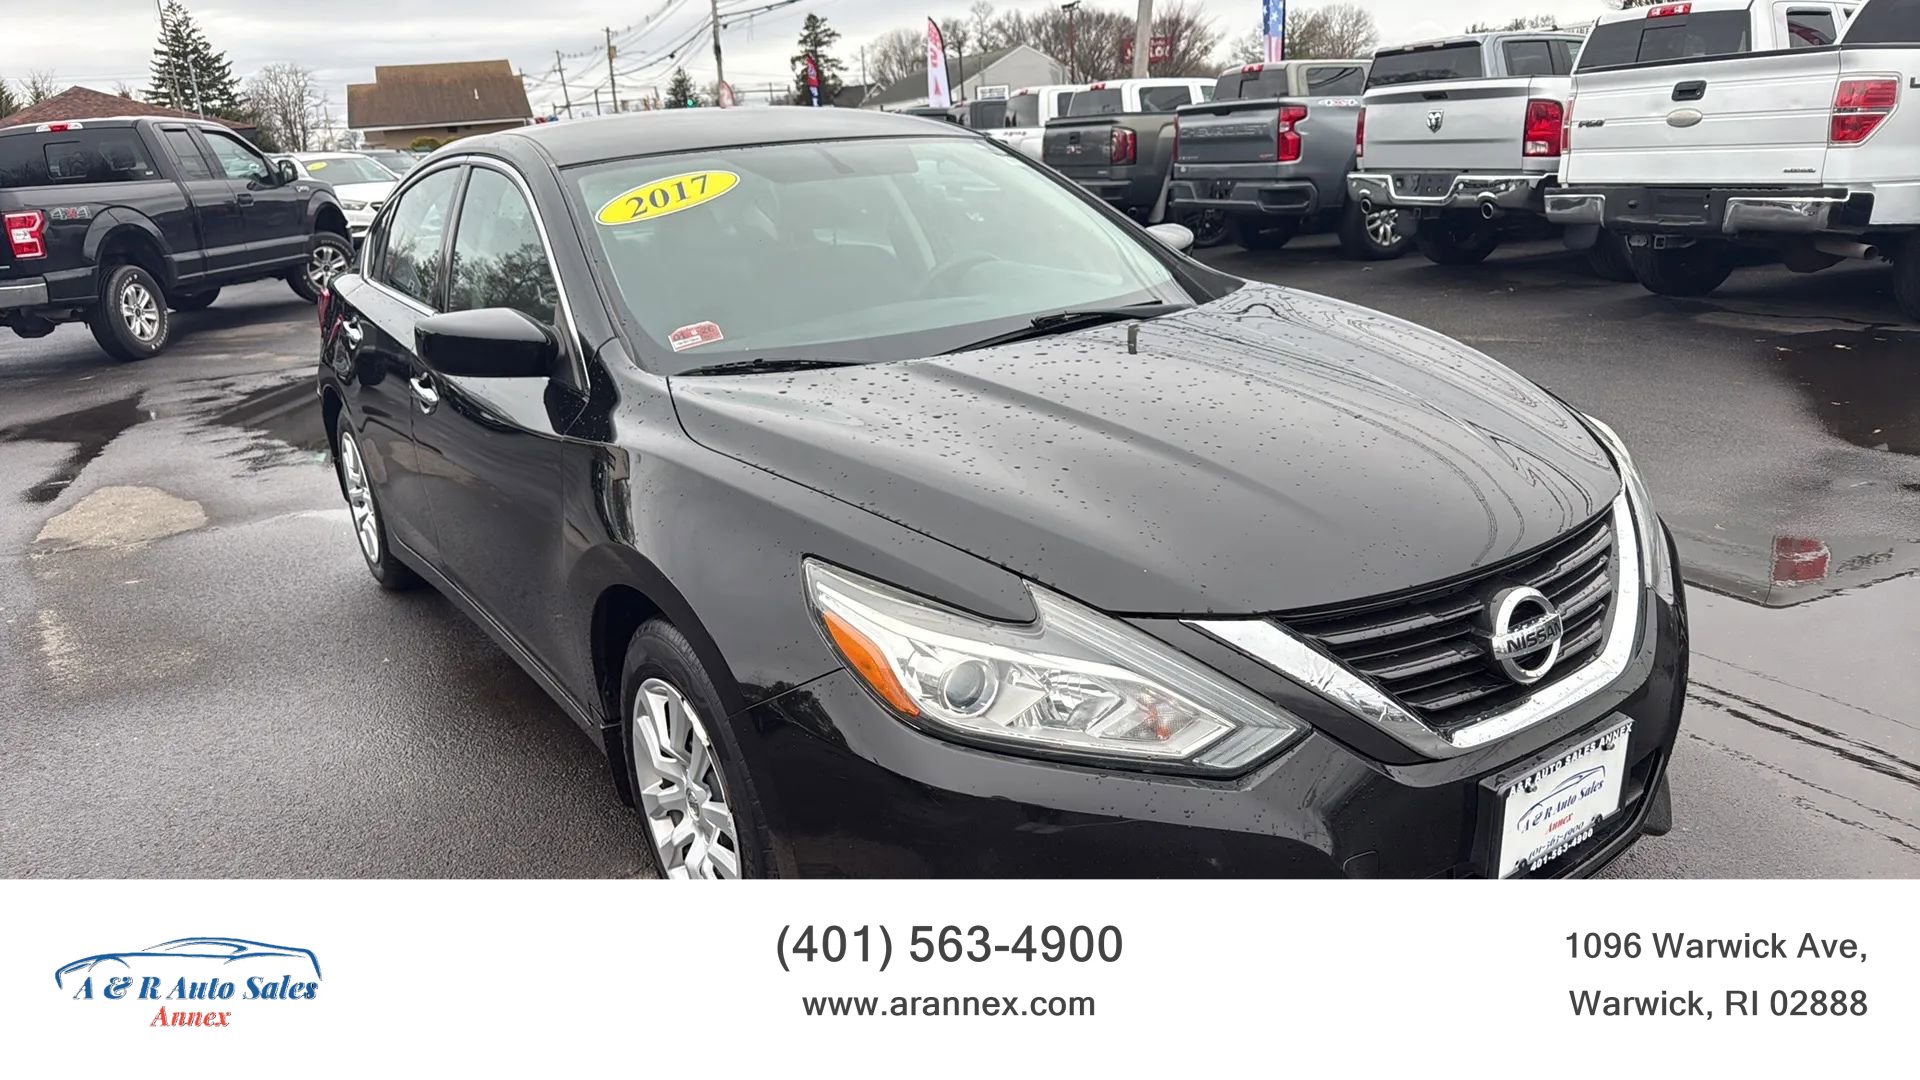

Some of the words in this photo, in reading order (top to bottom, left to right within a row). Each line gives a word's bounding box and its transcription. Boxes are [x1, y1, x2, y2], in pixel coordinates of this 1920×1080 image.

[626, 174, 708, 218] 2017
[1506, 622, 1561, 654] NISSAN
[1534, 759, 1563, 785] AUTO
[1564, 741, 1597, 767] SALES
[1598, 722, 1633, 750] ANNEX
[1578, 780, 1604, 800] Sales
[1545, 812, 1574, 835] Annex
[1530, 827, 1594, 871] 401-563-4900
